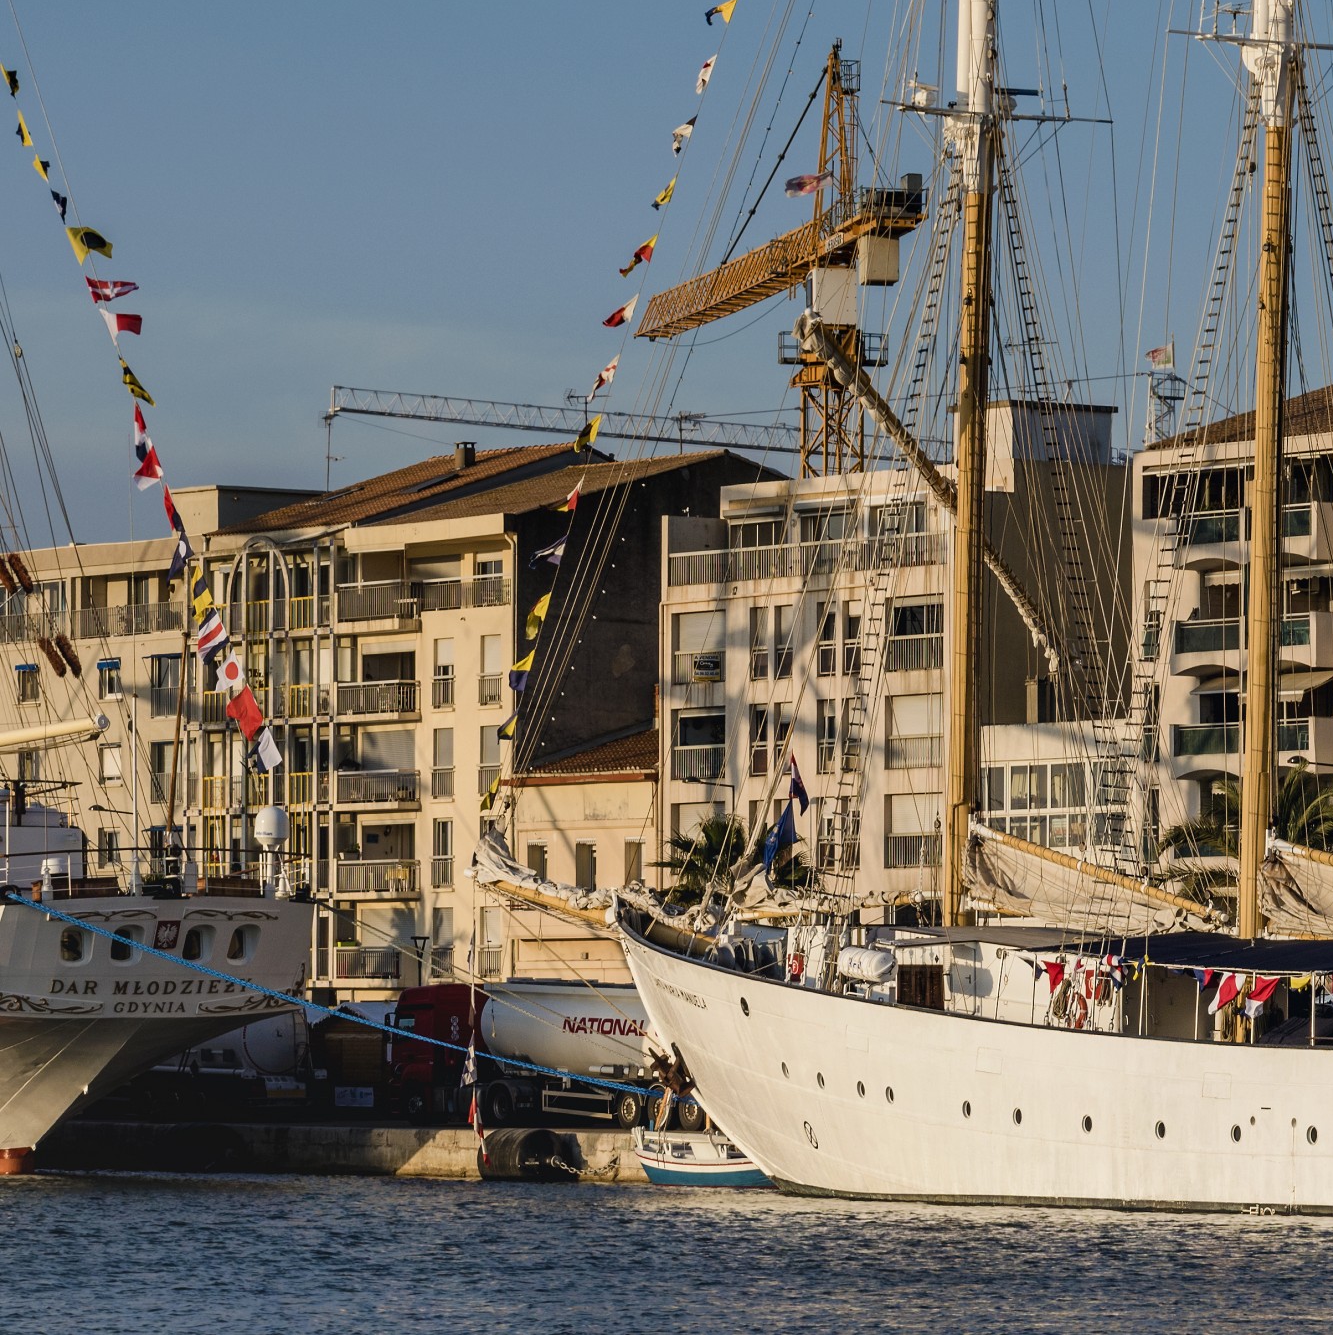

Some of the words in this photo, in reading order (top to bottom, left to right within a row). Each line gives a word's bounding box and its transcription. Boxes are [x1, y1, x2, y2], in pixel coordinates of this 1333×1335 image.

[50, 979, 99, 996] DAR
[113, 1001, 187, 1013] GDYNIA
[562, 1016, 648, 1038] NATIONAL
